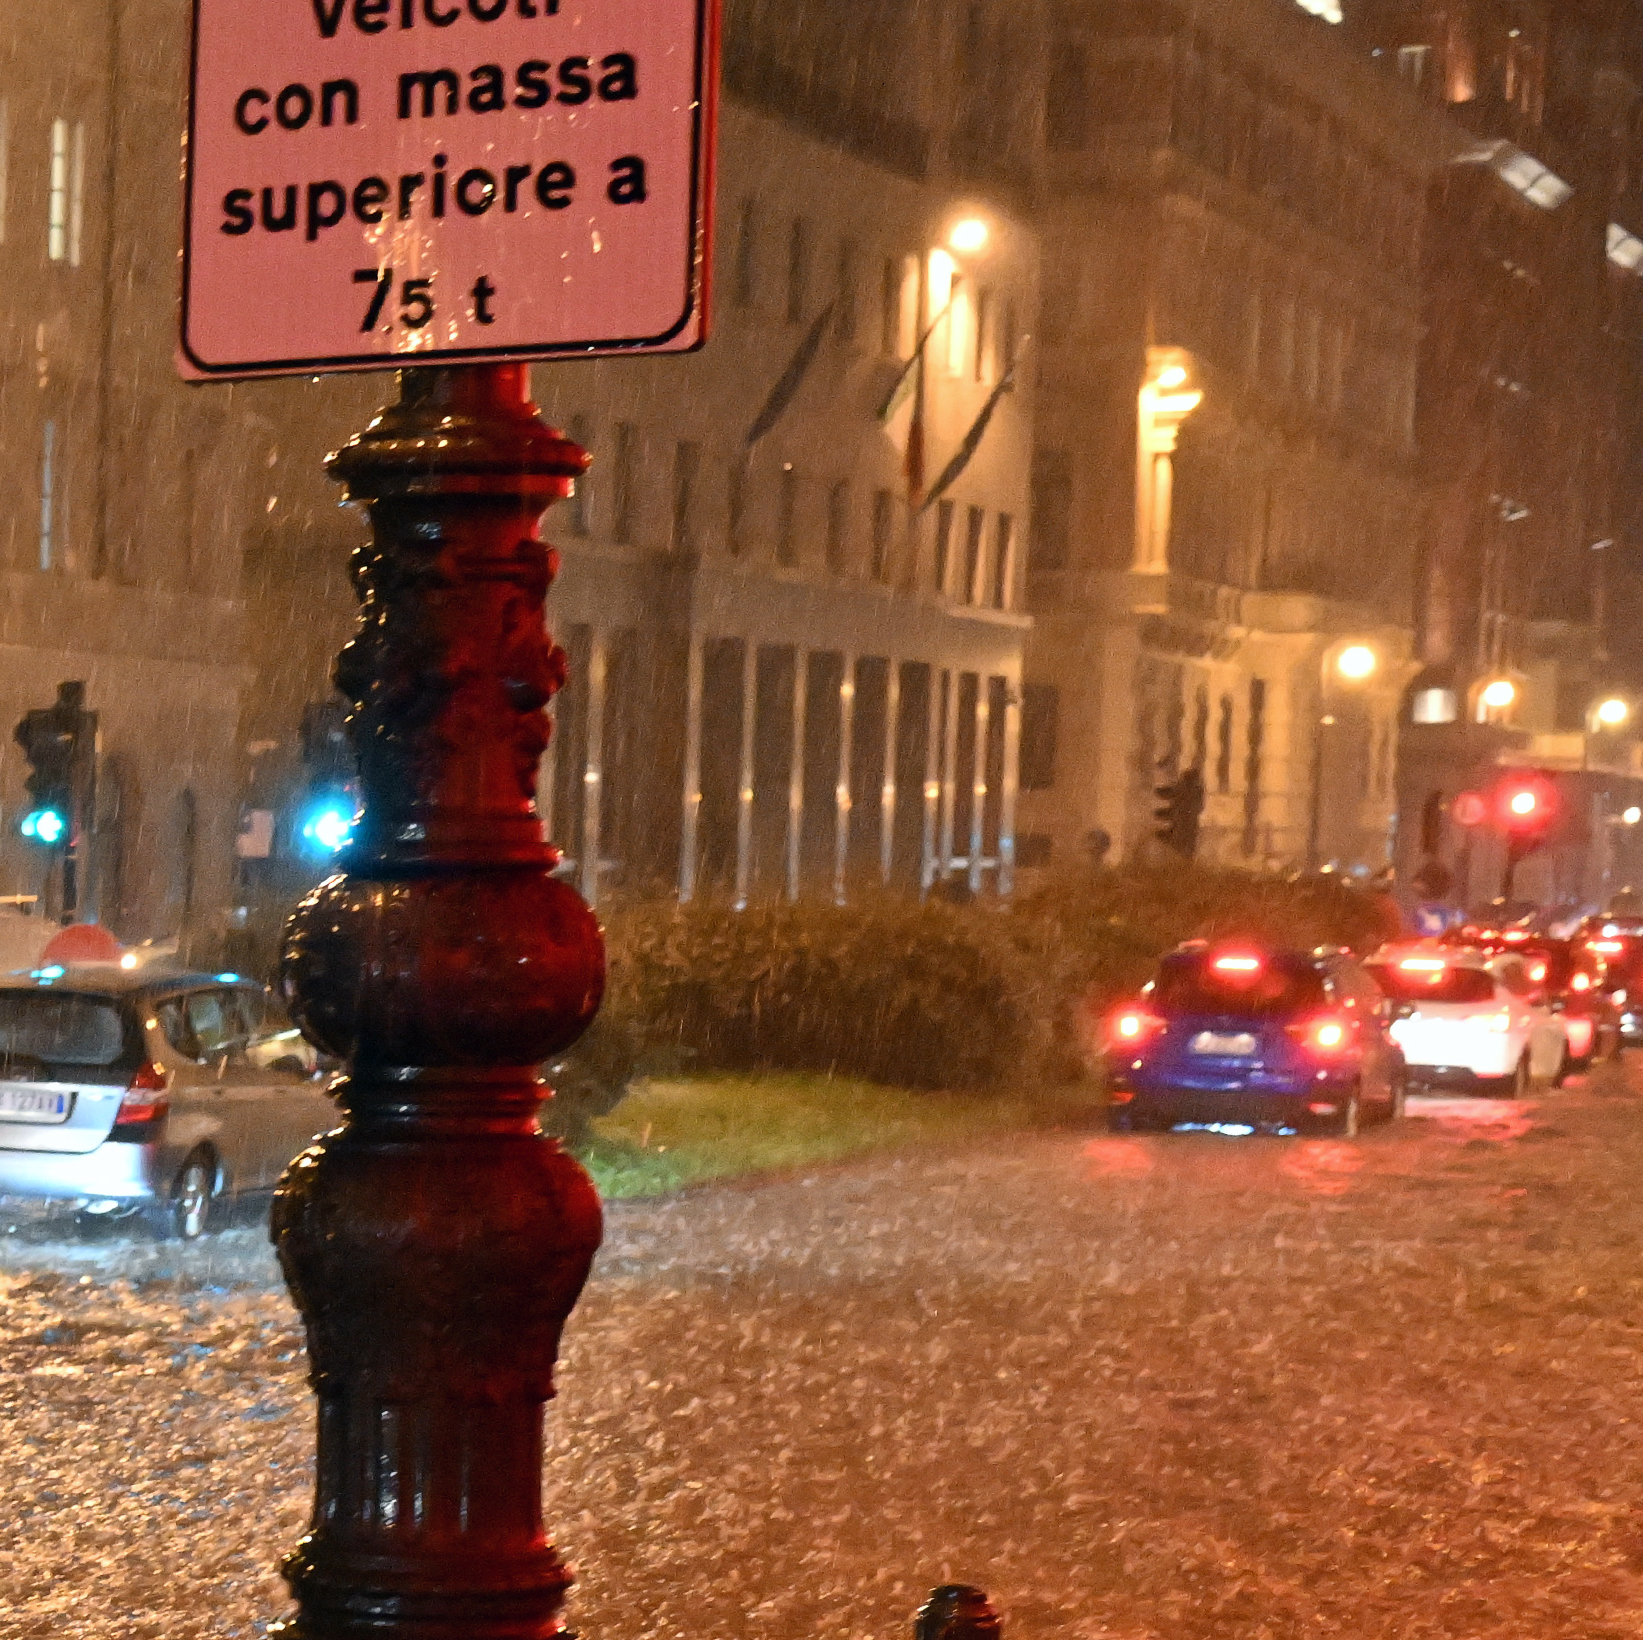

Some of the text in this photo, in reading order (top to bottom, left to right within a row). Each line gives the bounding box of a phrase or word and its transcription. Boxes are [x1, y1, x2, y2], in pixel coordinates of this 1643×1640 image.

[312, 0, 561, 38] veico
[233, 50, 640, 136] con massa
[219, 153, 648, 242] superiore a
[470, 275, 496, 325] t
